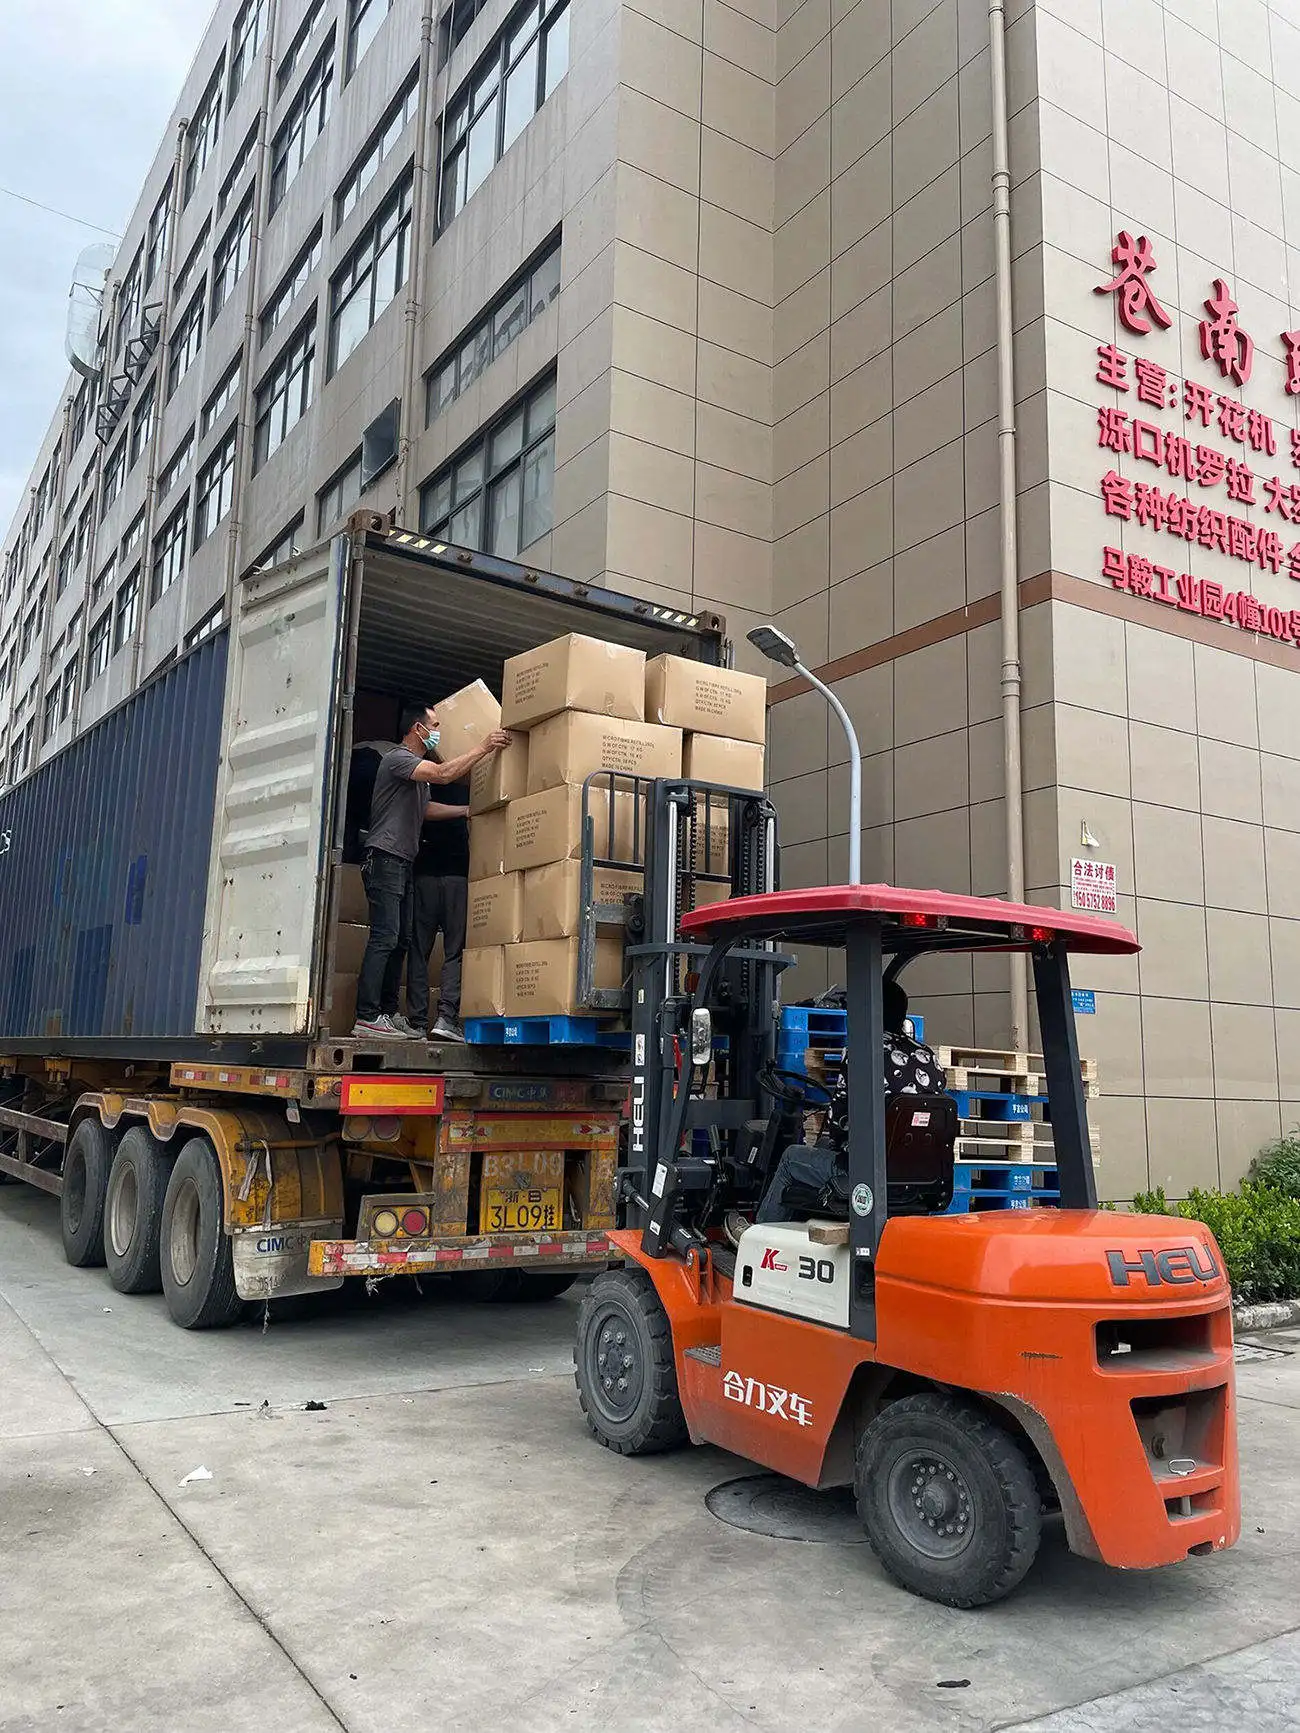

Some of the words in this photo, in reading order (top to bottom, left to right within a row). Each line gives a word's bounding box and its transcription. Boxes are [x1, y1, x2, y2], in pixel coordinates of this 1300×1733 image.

[1096, 343, 1276, 456] 主营：开花机
[1073, 860, 1115, 881] 合法讨债
[633, 1076, 645, 1152] HELI
[761, 1247, 781, 1271] K
[798, 1255, 835, 1284] 30
[722, 1370, 813, 1426] 合力叉车
